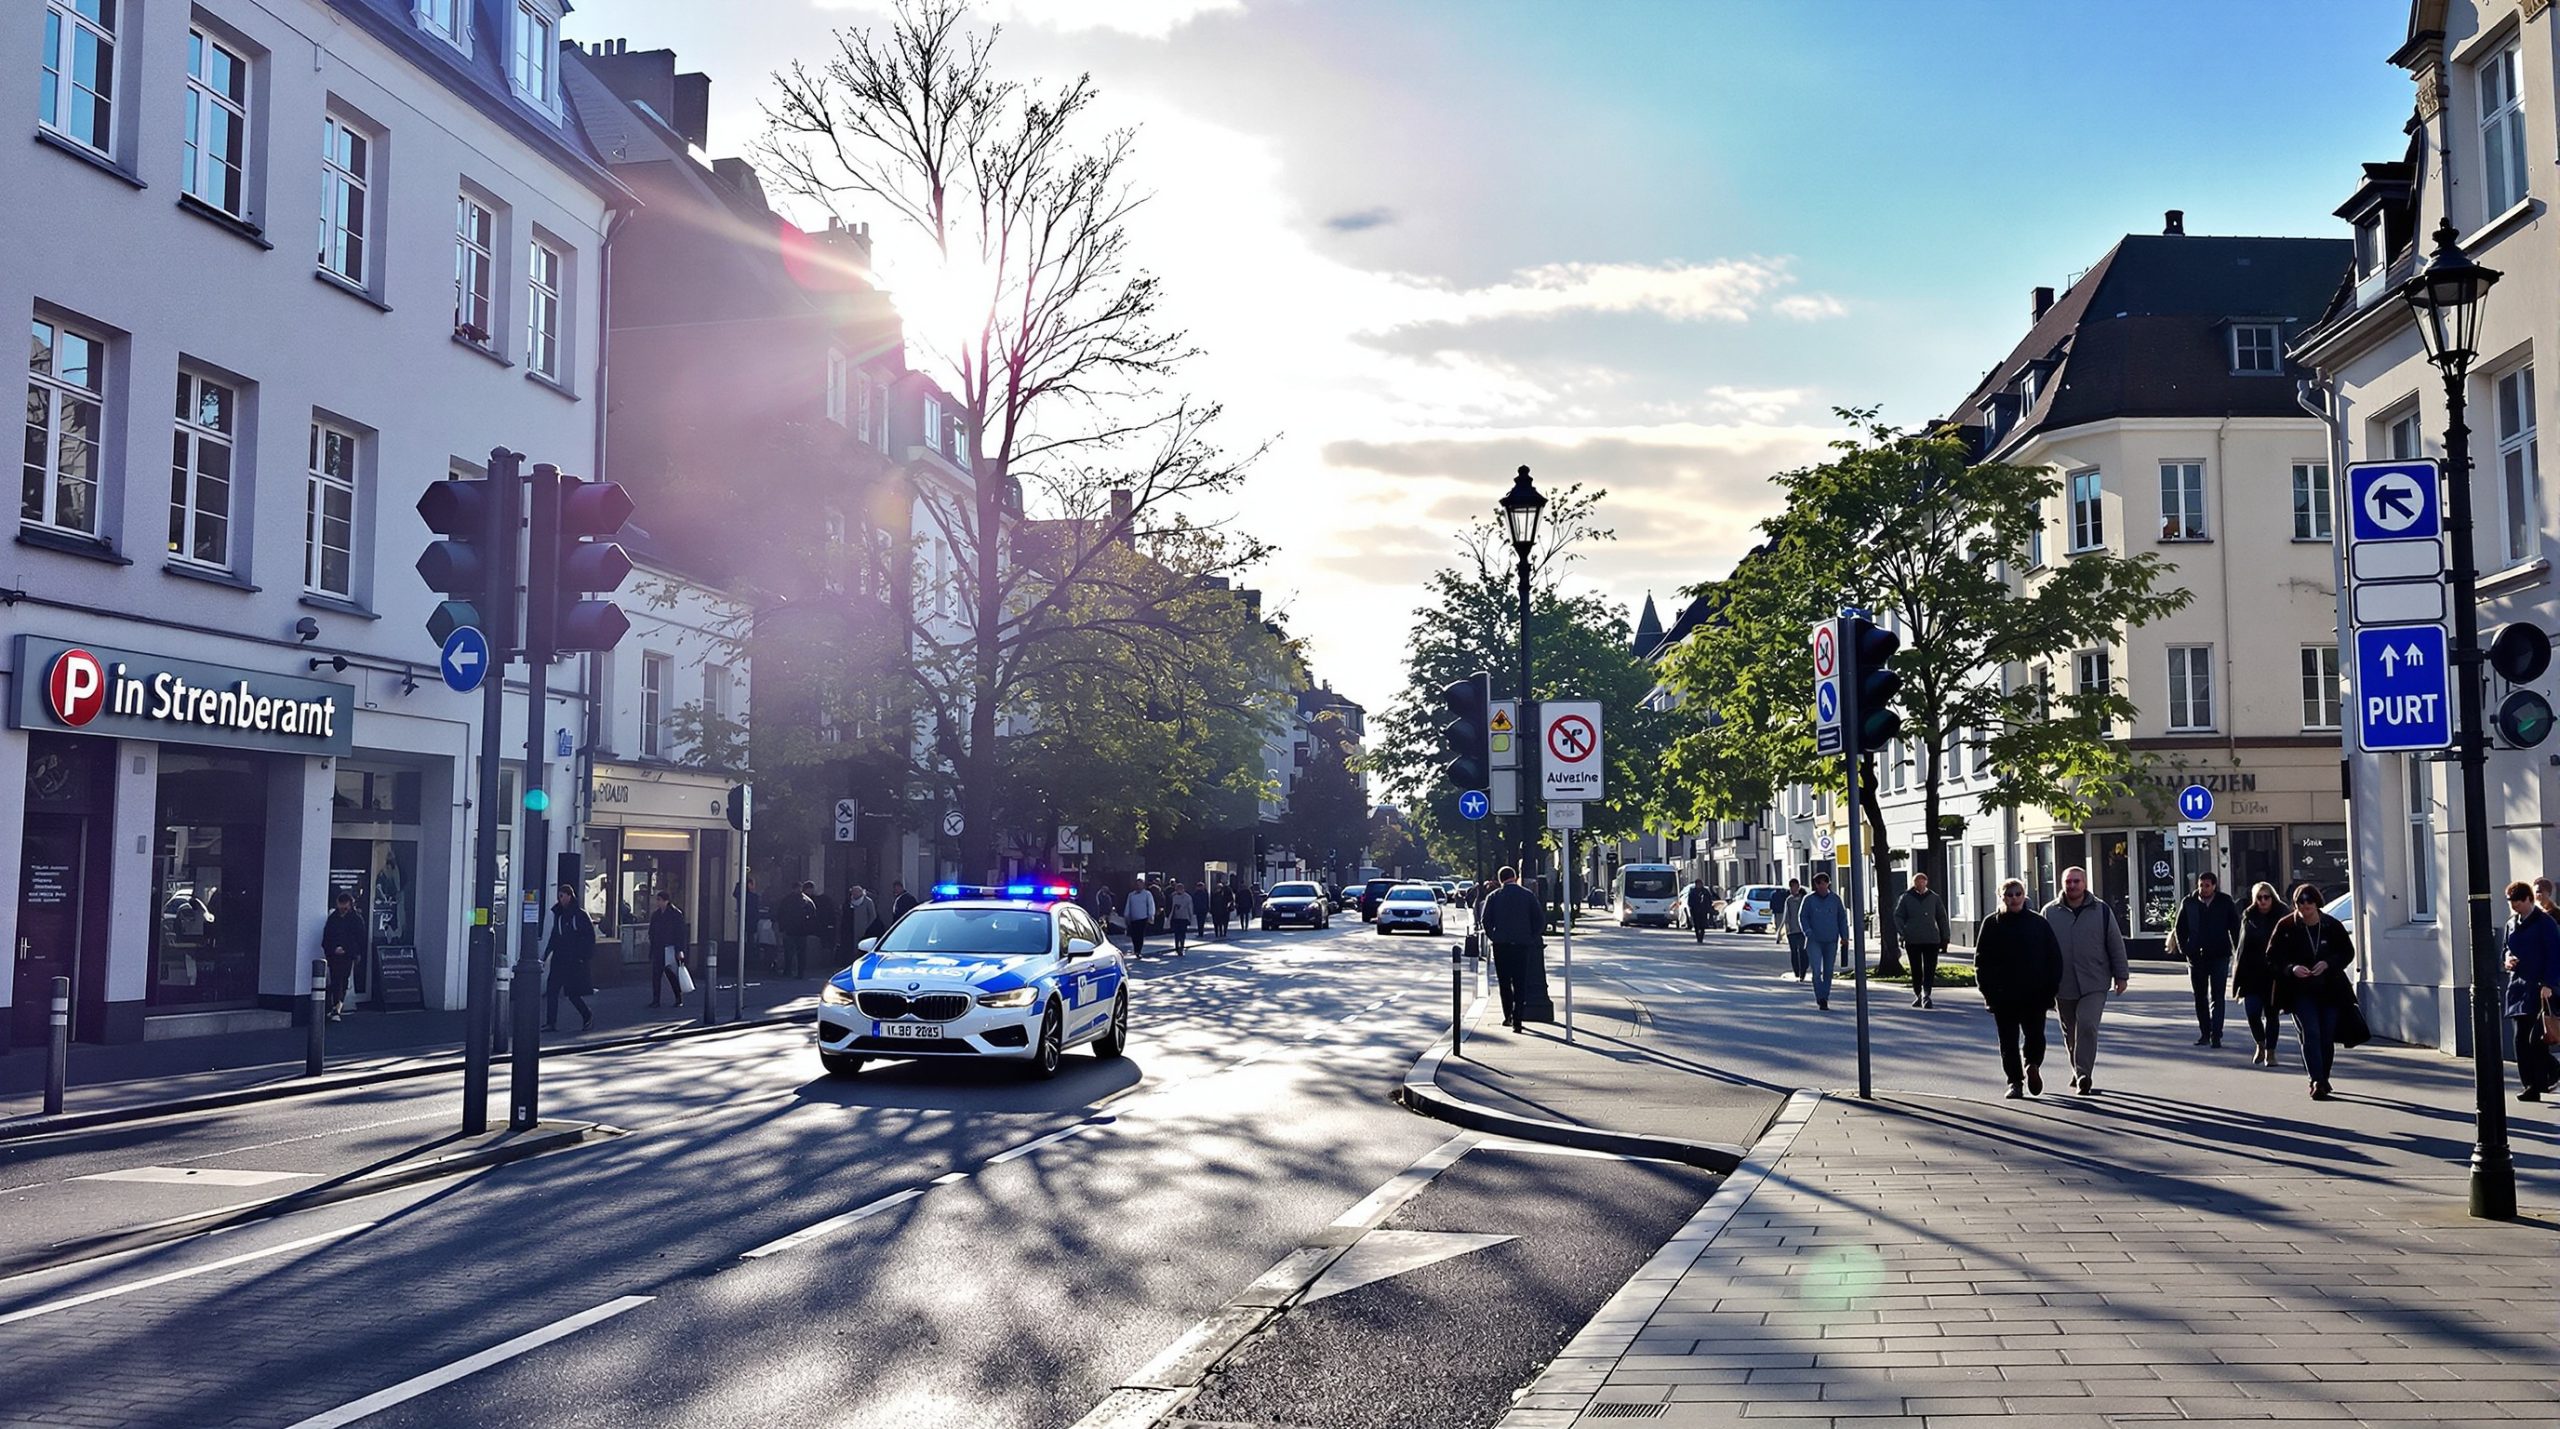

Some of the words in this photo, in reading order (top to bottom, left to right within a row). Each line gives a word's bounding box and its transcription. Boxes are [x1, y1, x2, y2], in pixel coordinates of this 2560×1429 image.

[63, 656, 99, 717] P
[114, 663, 145, 715] in
[2368, 693, 2439, 726] PURT
